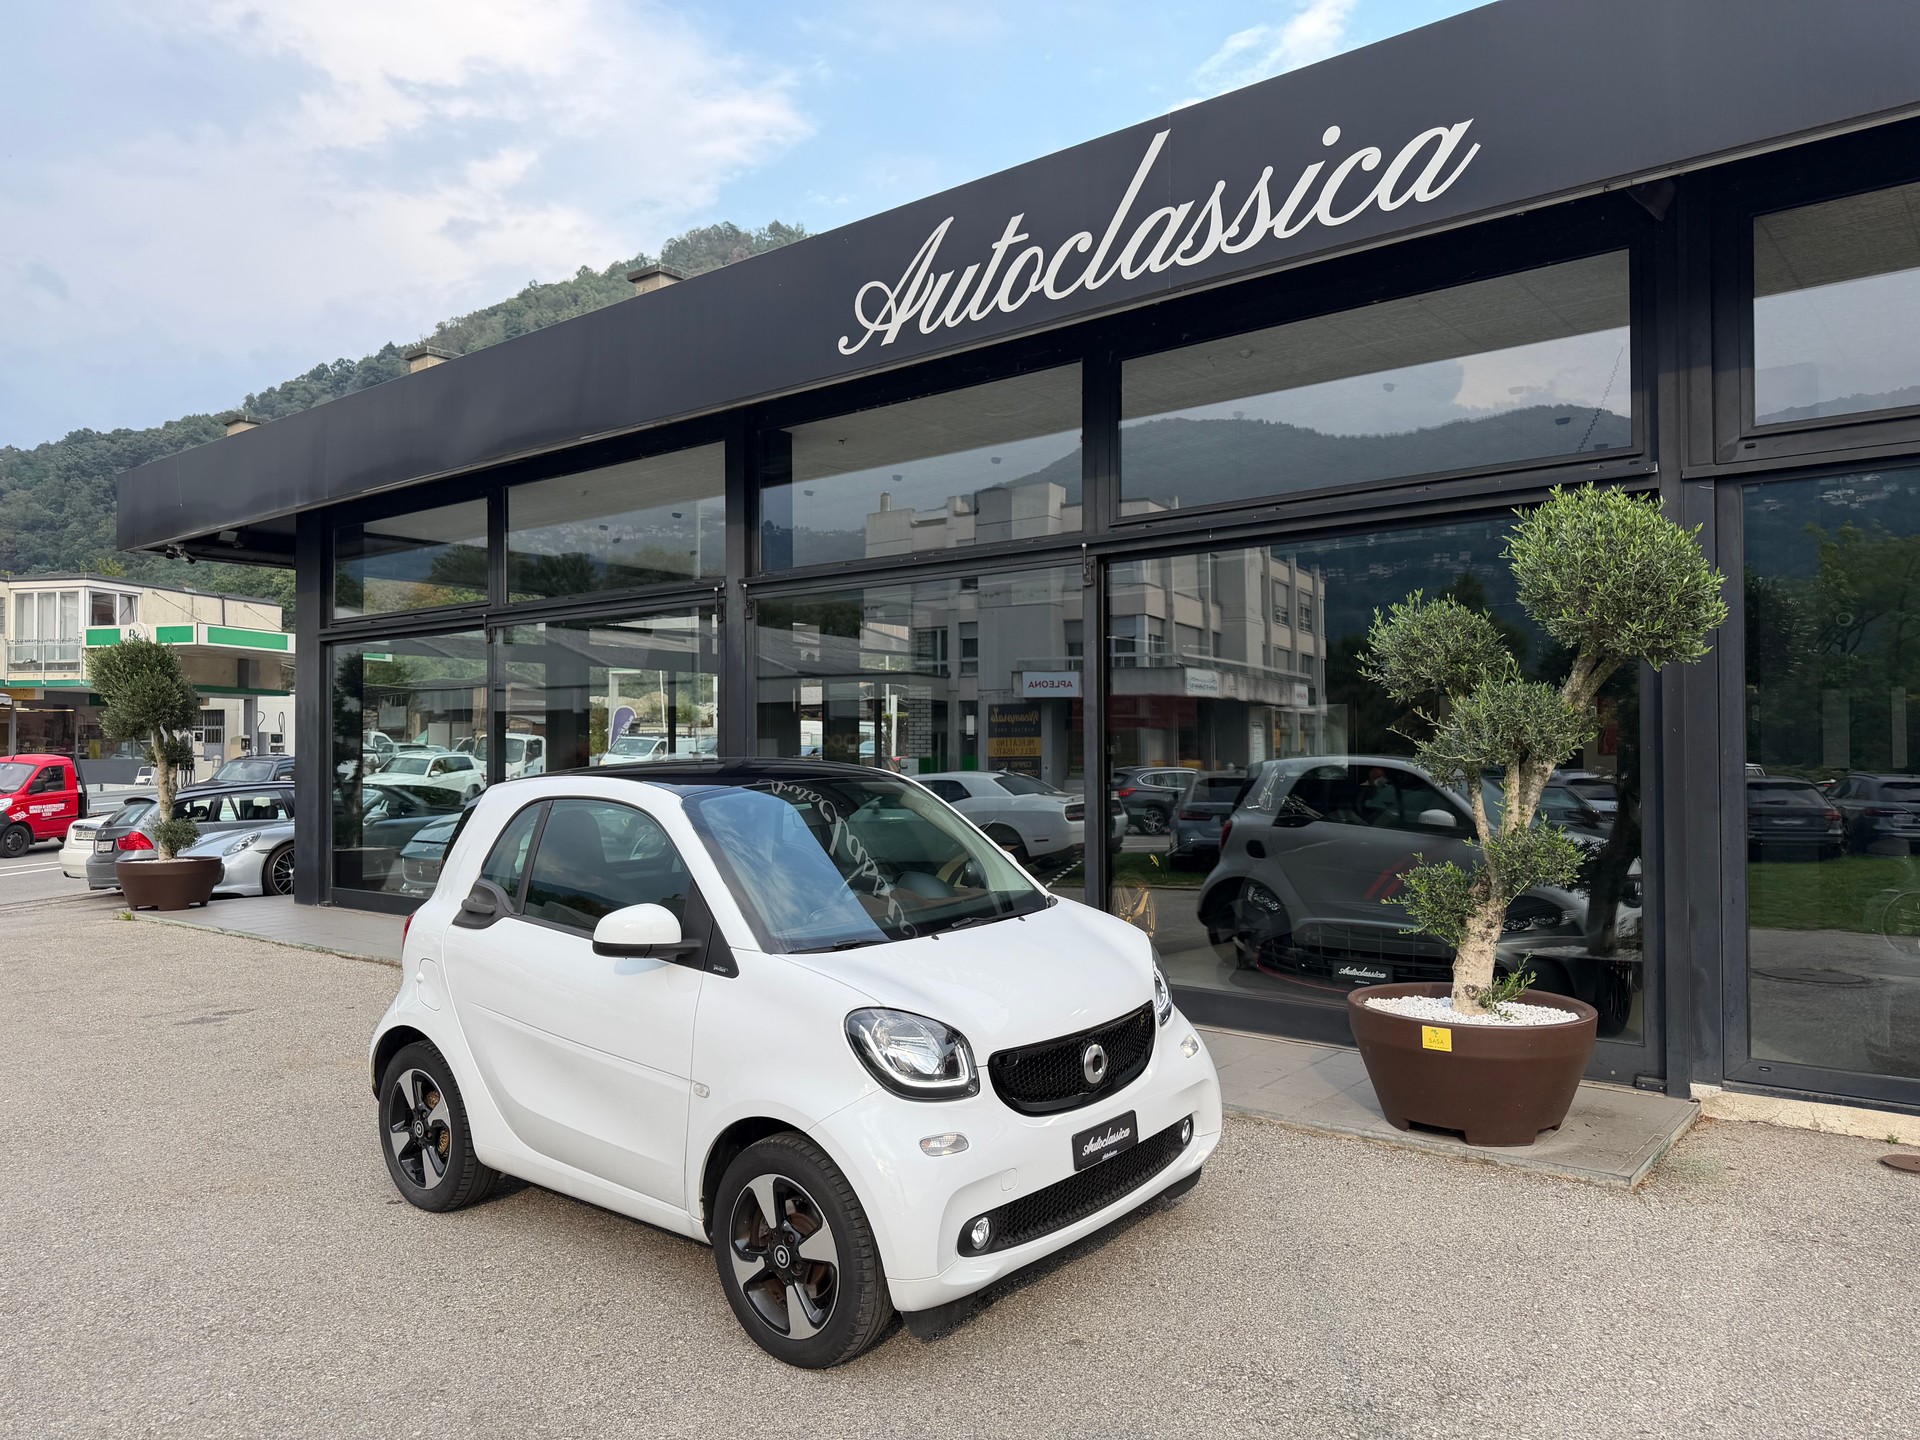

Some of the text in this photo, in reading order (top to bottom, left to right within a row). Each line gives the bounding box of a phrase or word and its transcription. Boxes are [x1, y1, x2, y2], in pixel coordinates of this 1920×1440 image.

[837, 118, 1482, 356] Autoclassica
[1339, 966, 1387, 979] Autoclassica
[1082, 1127, 1131, 1157] Autoclassica
